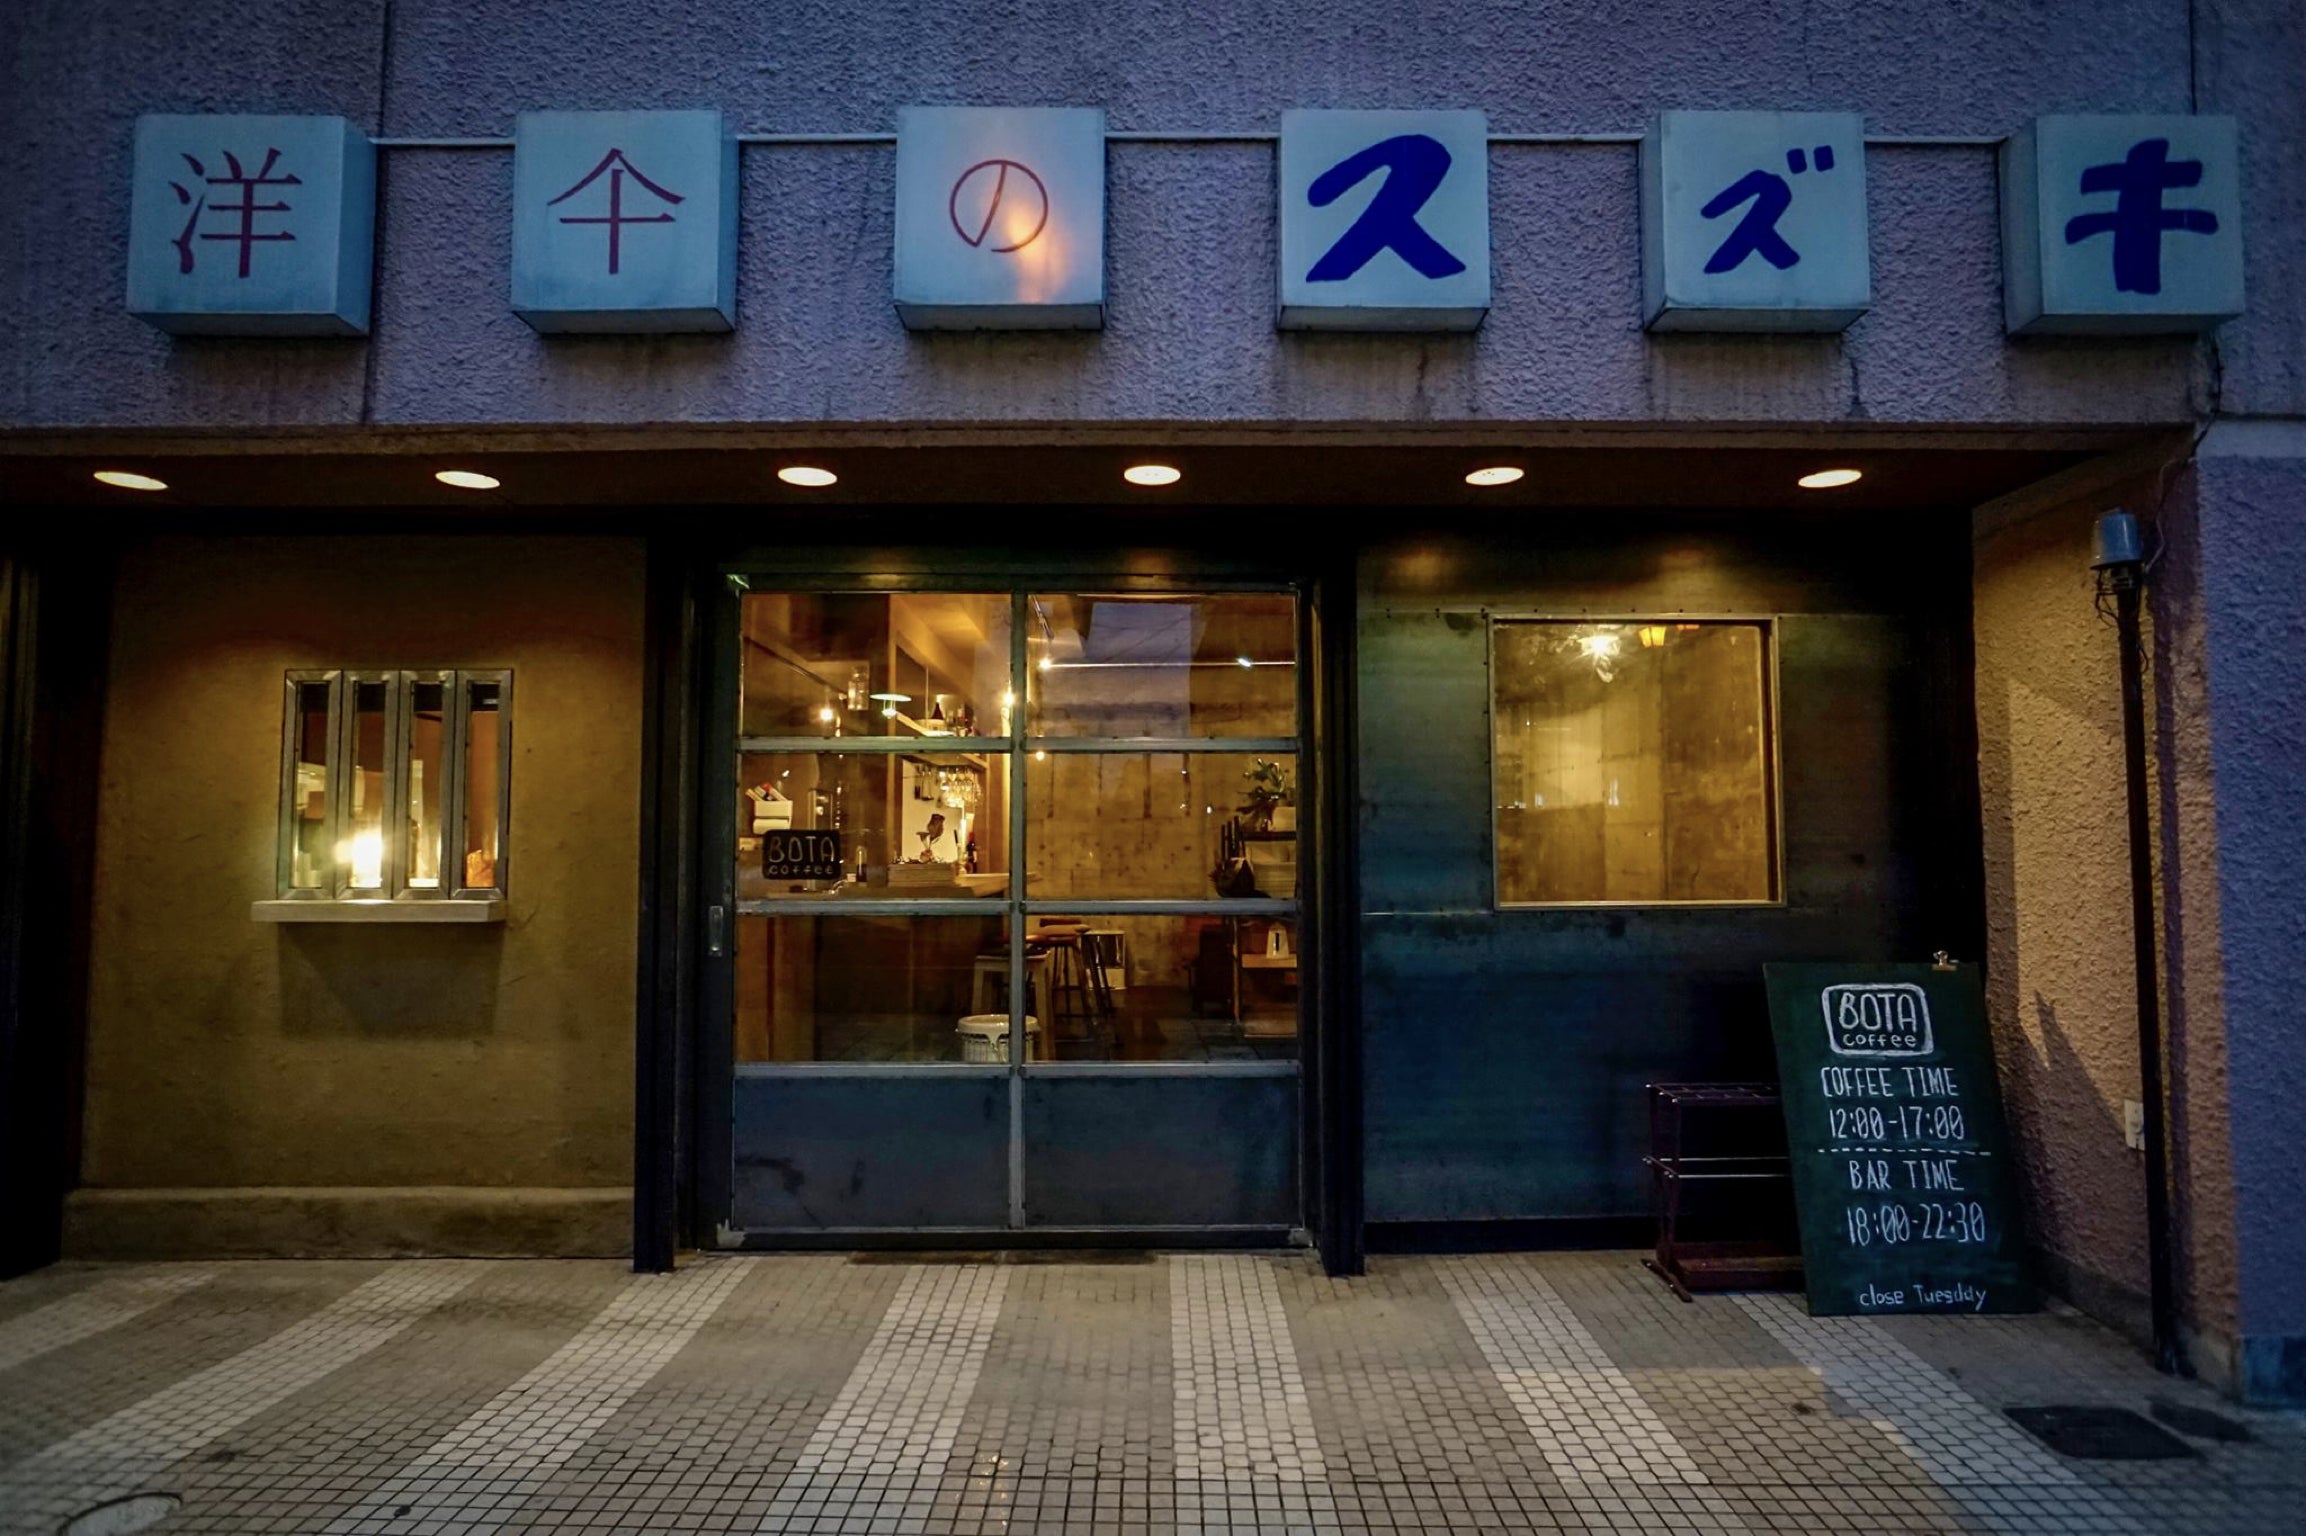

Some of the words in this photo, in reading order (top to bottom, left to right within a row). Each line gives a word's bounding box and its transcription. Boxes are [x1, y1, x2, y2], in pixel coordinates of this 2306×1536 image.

[768, 835, 835, 863] BOTA
[1838, 992, 1917, 1033] BOTA
[1842, 1032, 1917, 1048] coffee
[1821, 1067, 1894, 1098] COFFEE
[1901, 1067, 1959, 1097] TIME
[1849, 1160, 1891, 1190] BAR
[1902, 1160, 1965, 1191] TIME
[1859, 1283, 1904, 1306] close
